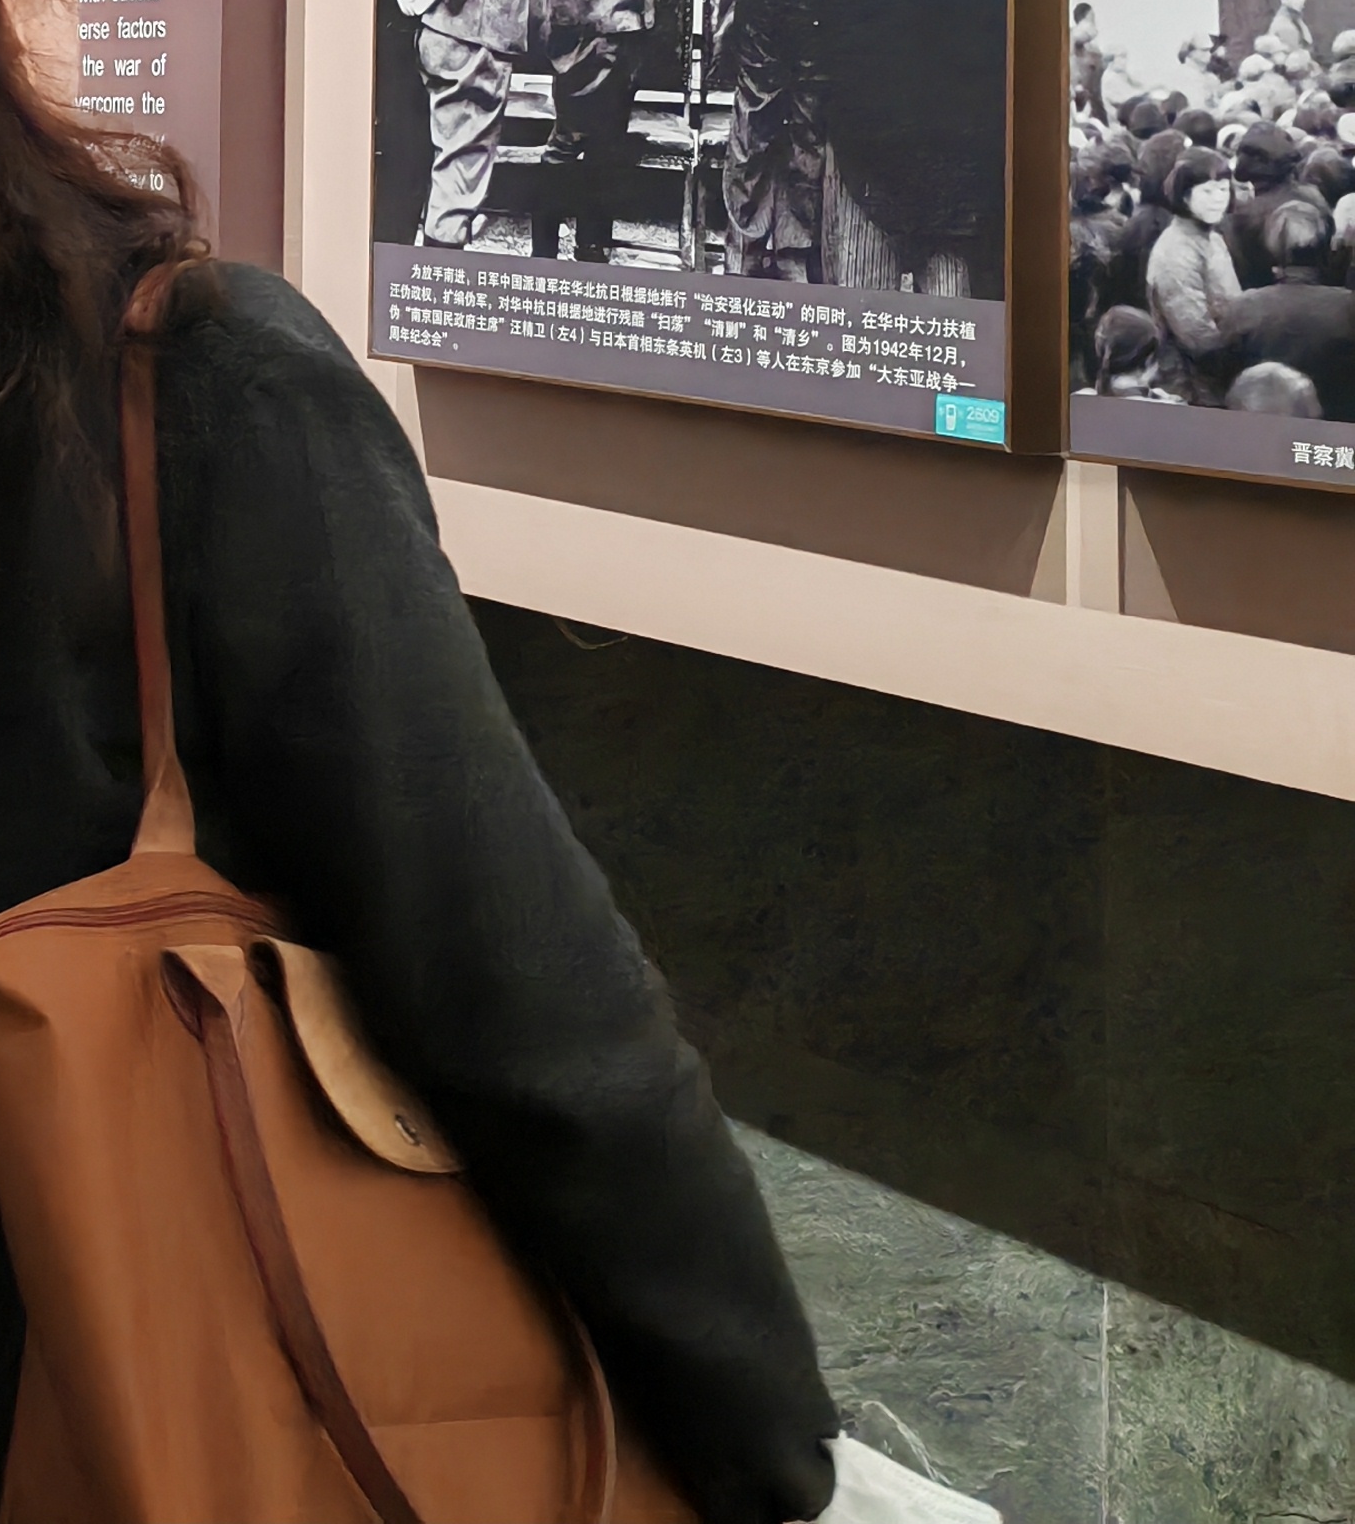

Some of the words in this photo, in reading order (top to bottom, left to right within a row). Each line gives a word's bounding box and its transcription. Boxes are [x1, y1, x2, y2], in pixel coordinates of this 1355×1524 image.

[77, 21, 110, 40] erse
[117, 16, 166, 38] factors
[82, 55, 104, 76] the
[114, 59, 141, 76] war
[151, 53, 167, 76] of
[74, 94, 134, 115] vercome
[142, 91, 165, 114] the
[150, 168, 164, 191] to
